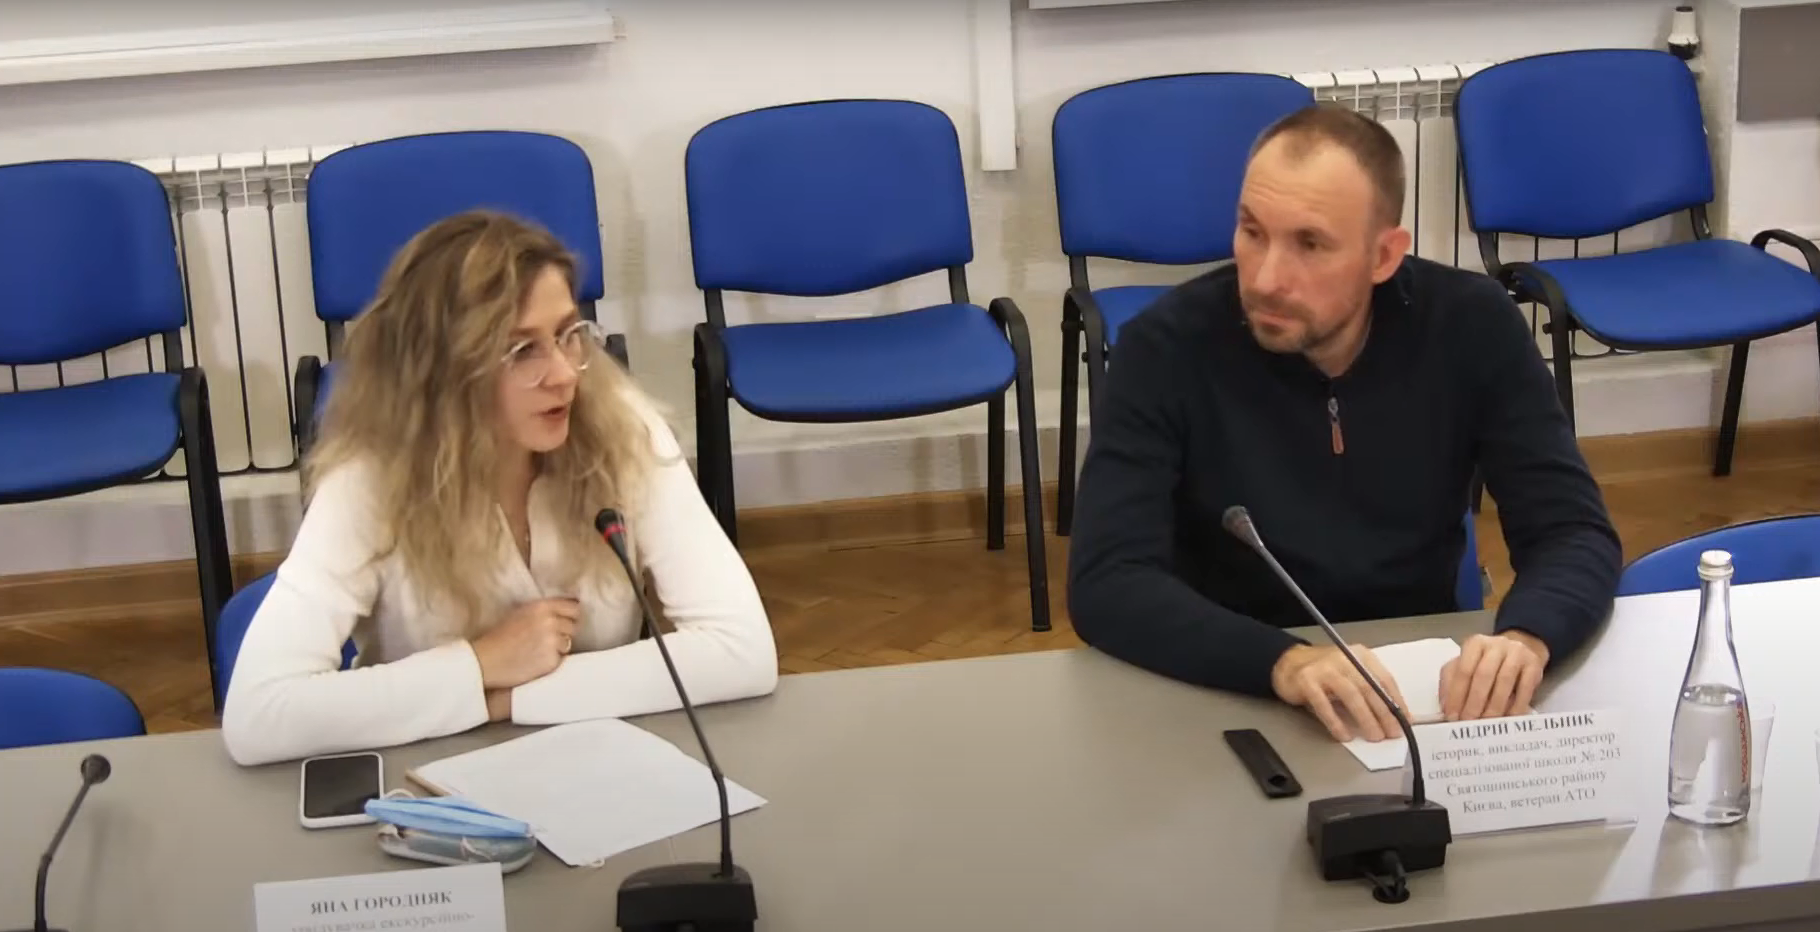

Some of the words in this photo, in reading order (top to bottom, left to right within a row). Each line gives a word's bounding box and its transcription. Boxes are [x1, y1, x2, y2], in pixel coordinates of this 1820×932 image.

[1449, 722, 1509, 740] АНДРІЙ
[1513, 712, 1594, 735] МЕЛЬНИК
[1431, 745, 1485, 761] історик,
[1556, 731, 1615, 750] директор
[1428, 757, 1530, 780] спеціалізованої
[1534, 755, 1577, 769] школи
[1581, 749, 1596, 763] №
[1599, 747, 1621, 761] 203
[1446, 775, 1558, 797] Святошинського
[1561, 770, 1606, 788] району
[1510, 794, 1561, 810] ветеран
[1564, 787, 1596, 803] АТО
[311, 900, 348, 915] ЯНА
[353, 890, 452, 912] ГОРОДНЯК
